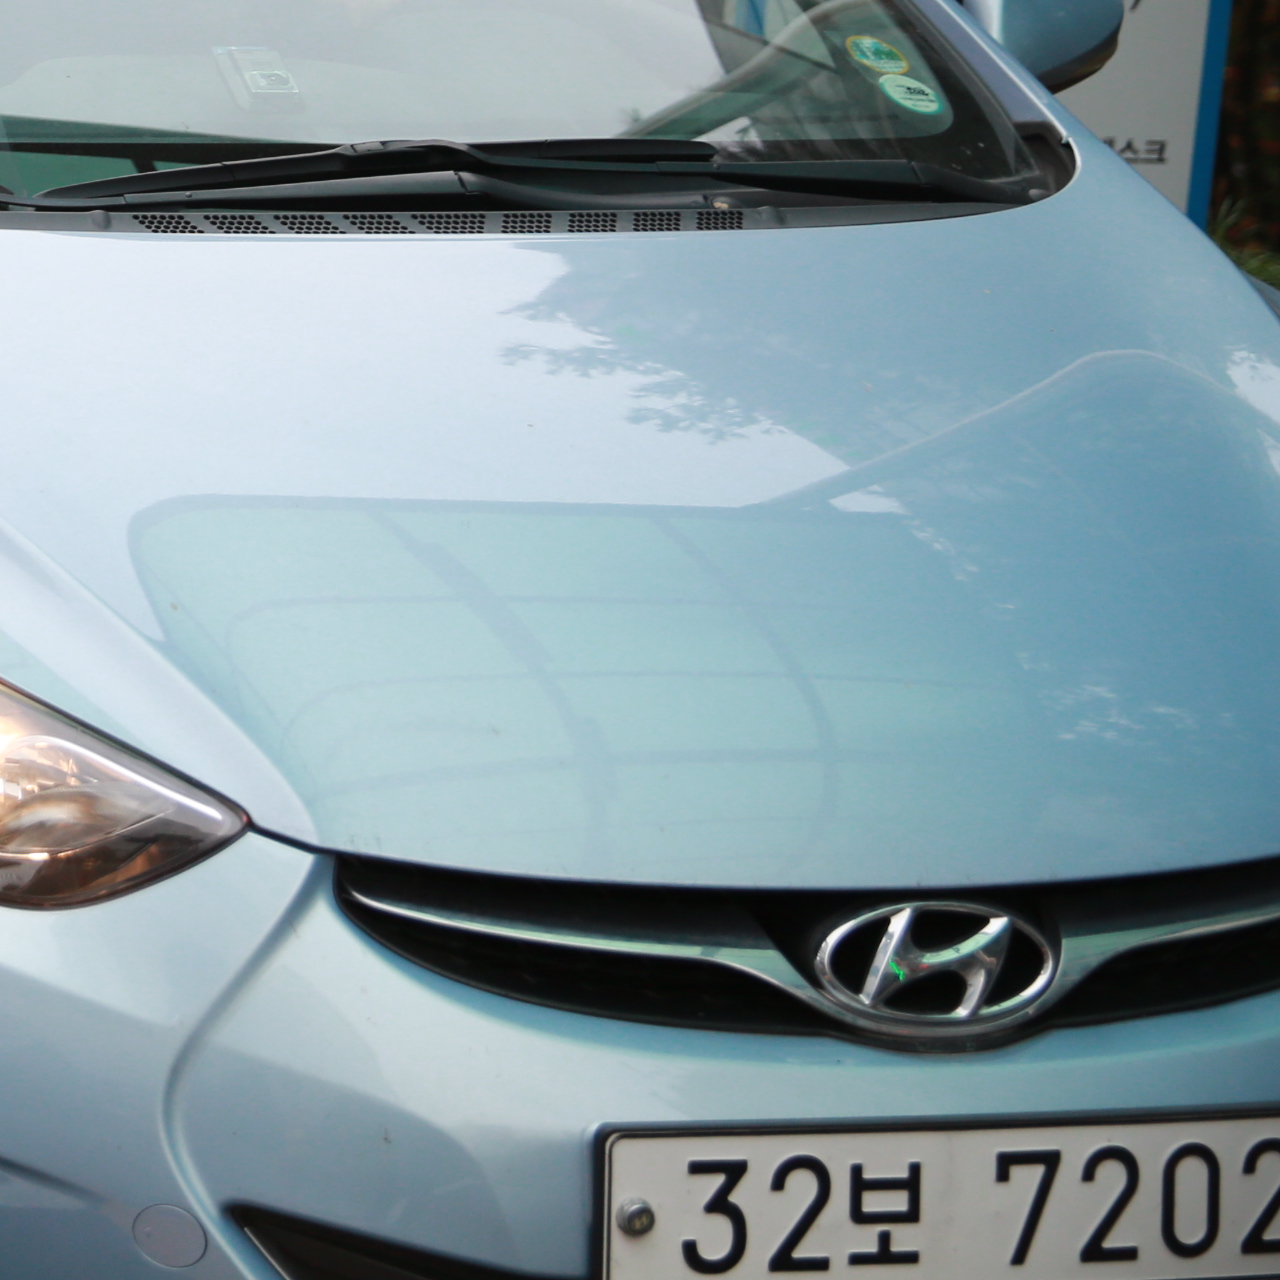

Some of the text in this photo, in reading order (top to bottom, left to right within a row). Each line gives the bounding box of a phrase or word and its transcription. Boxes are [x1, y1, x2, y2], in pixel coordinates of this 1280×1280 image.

[1103, 136, 1166, 164] 스크
[681, 1137, 1280, 1275] 32보 7202
